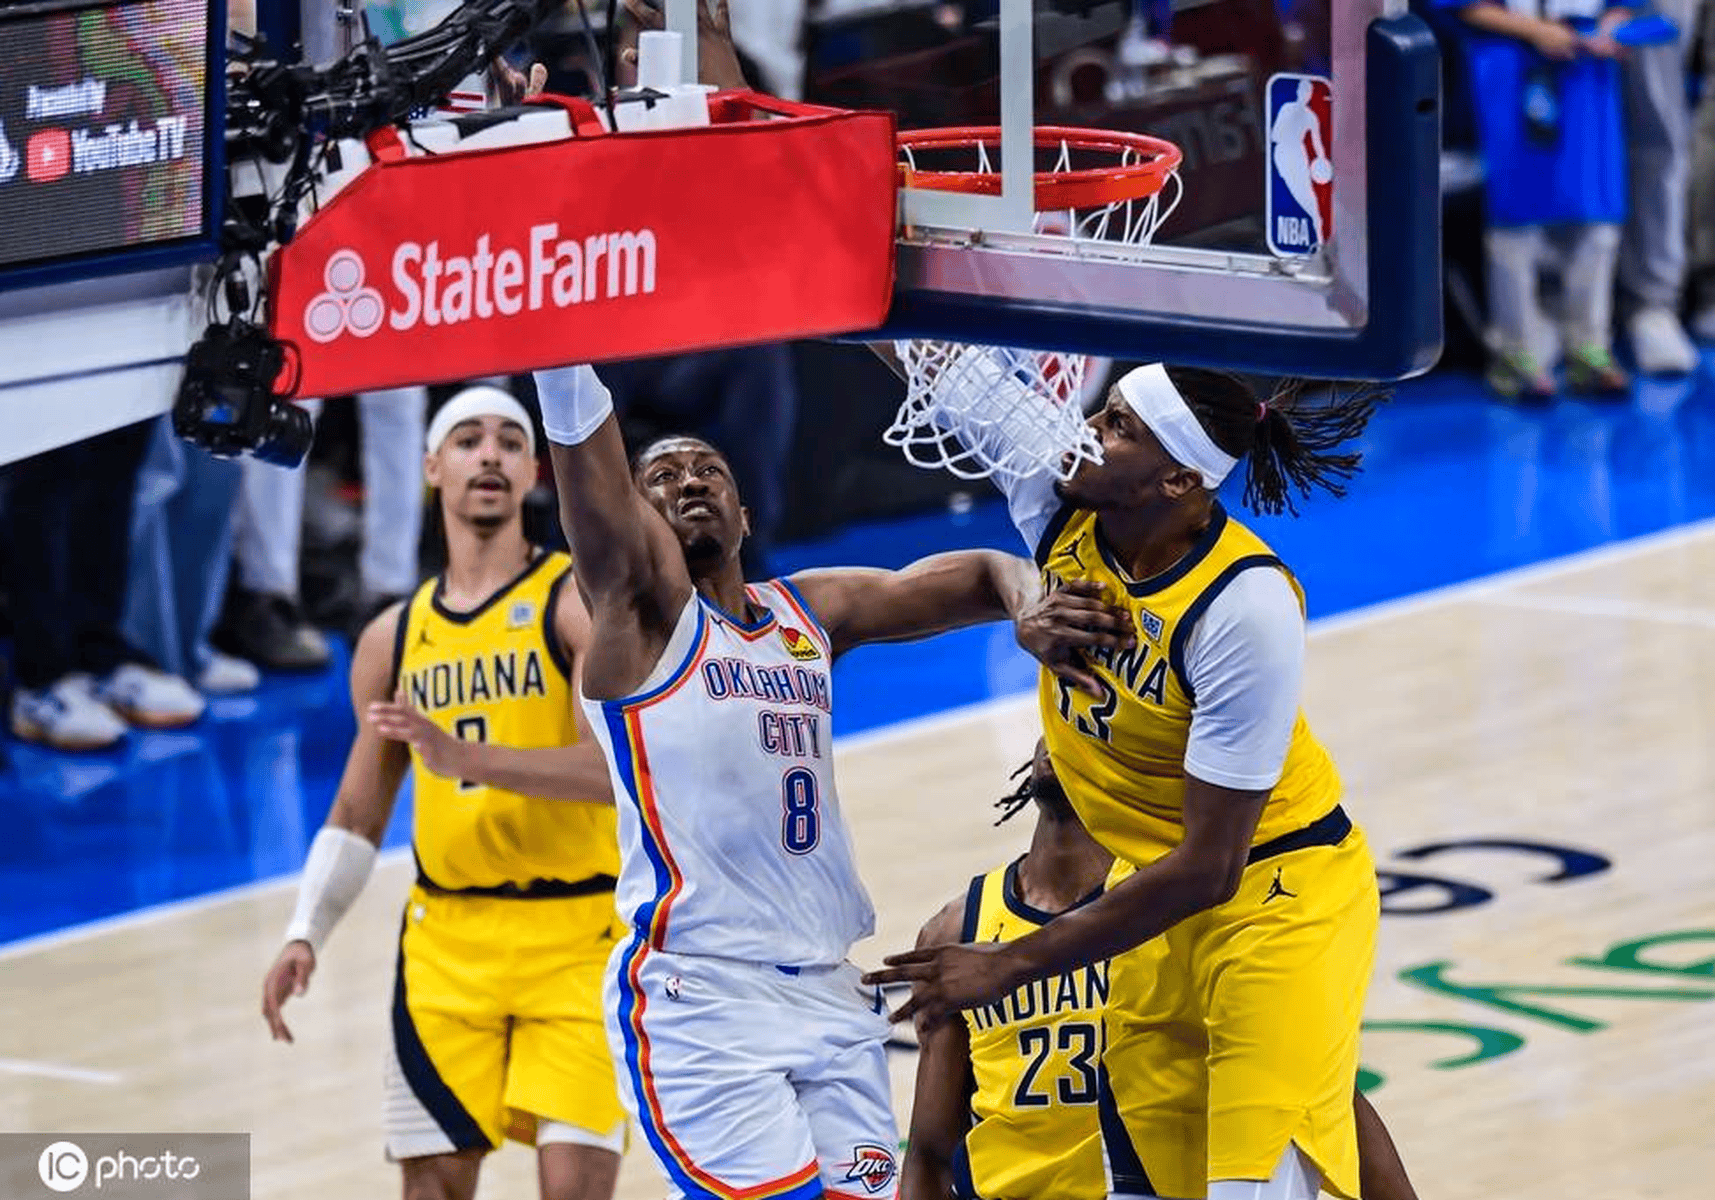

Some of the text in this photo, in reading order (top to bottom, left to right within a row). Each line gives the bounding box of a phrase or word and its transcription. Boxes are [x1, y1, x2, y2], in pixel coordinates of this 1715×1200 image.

[1277, 215, 1310, 247] NBA
[701, 657, 831, 712] OKLAHOM
[758, 709, 821, 759] CITY
[782, 765, 821, 856] 8
[972, 958, 1111, 1031] NDIAN
[1014, 1022, 1098, 1107] 23
